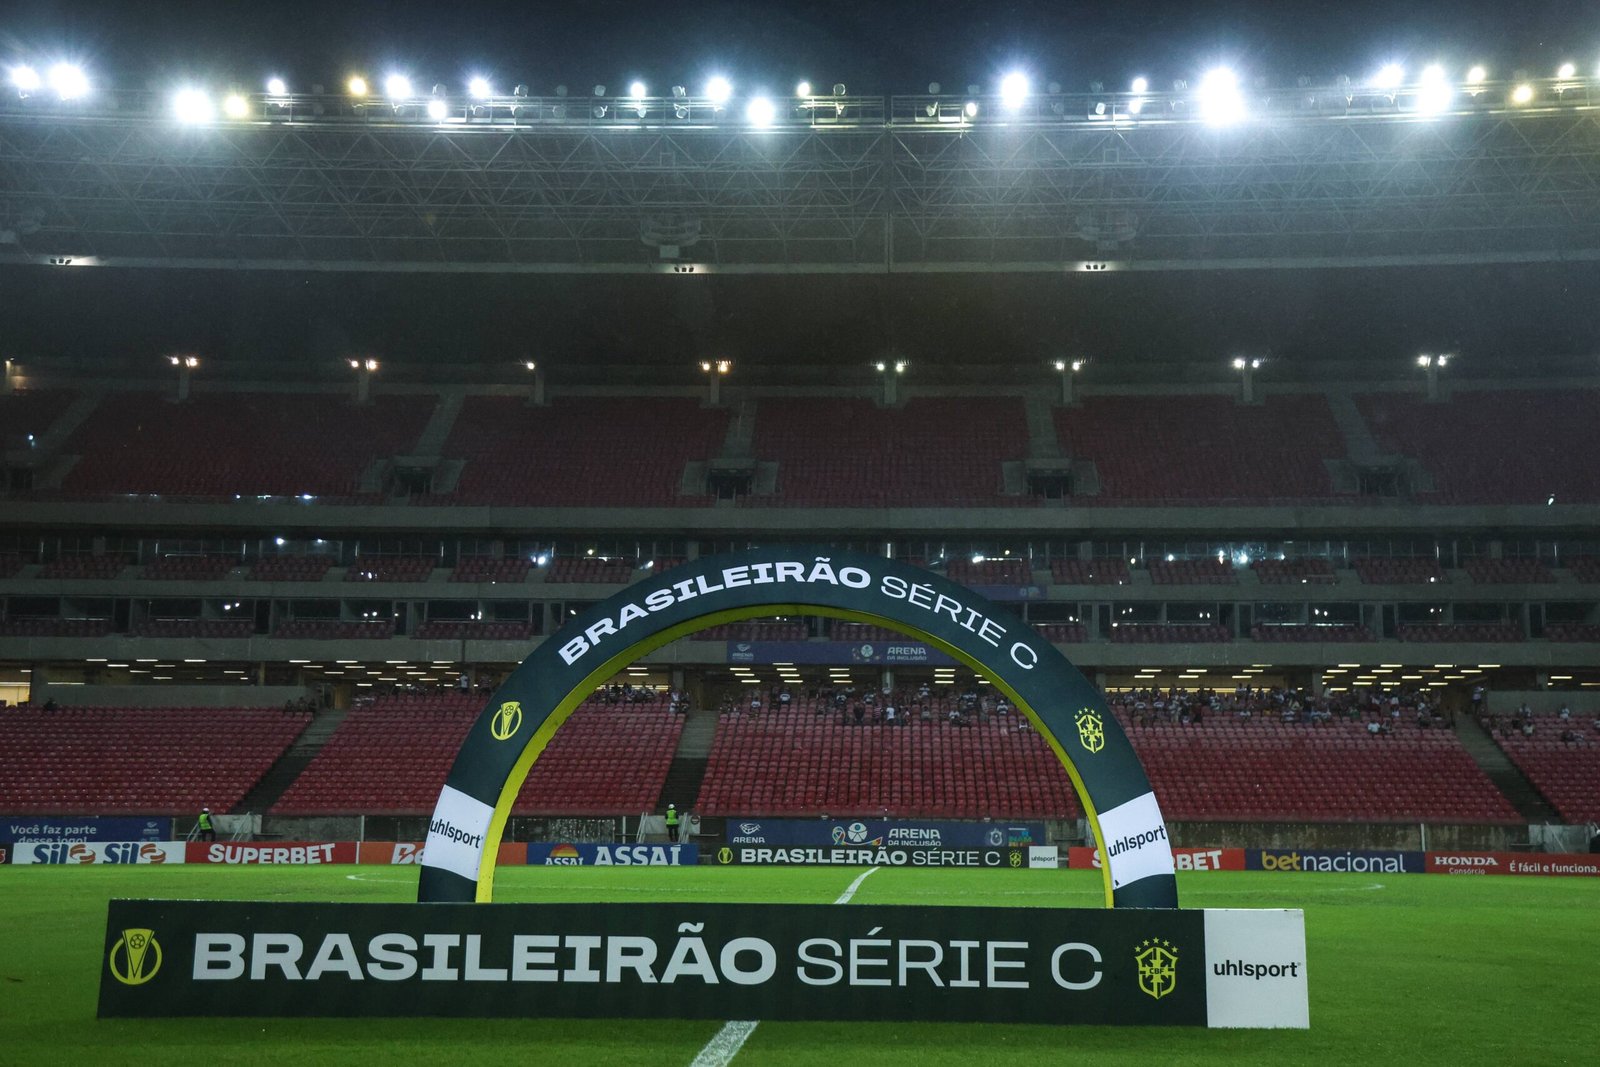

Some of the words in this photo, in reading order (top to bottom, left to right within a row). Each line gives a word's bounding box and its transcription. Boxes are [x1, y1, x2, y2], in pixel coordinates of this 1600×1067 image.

[558, 557, 871, 666] BRASILEIRÃO
[881, 576, 1007, 648] SÉRIE
[1010, 642, 1038, 670] C
[887, 647, 927, 655] ARENA
[11, 825, 40, 834] Você
[43, 825, 61, 834] faz
[65, 825, 97, 836] parte
[430, 819, 481, 849] uhlsport
[888, 828, 941, 839] ARENA
[732, 836, 766, 844] ARENA
[1108, 825, 1166, 857] uhlsport
[207, 843, 336, 864] SUPERBET
[741, 846, 907, 865] BRASILEIRÃO
[912, 847, 980, 866] SÉRIE
[985, 851, 1001, 866] C
[1031, 855, 1056, 863] uhlsport
[1434, 856, 1499, 866] HONDA
[1509, 860, 1516, 872] É
[1518, 862, 1540, 872] fácil
[1448, 867, 1486, 875] Consórcio
[193, 922, 777, 985] BRASILEIRÃO
[796, 926, 1030, 989] SÉRIE
[1051, 942, 1104, 991] C
[1213, 959, 1298, 980] uhlsport
